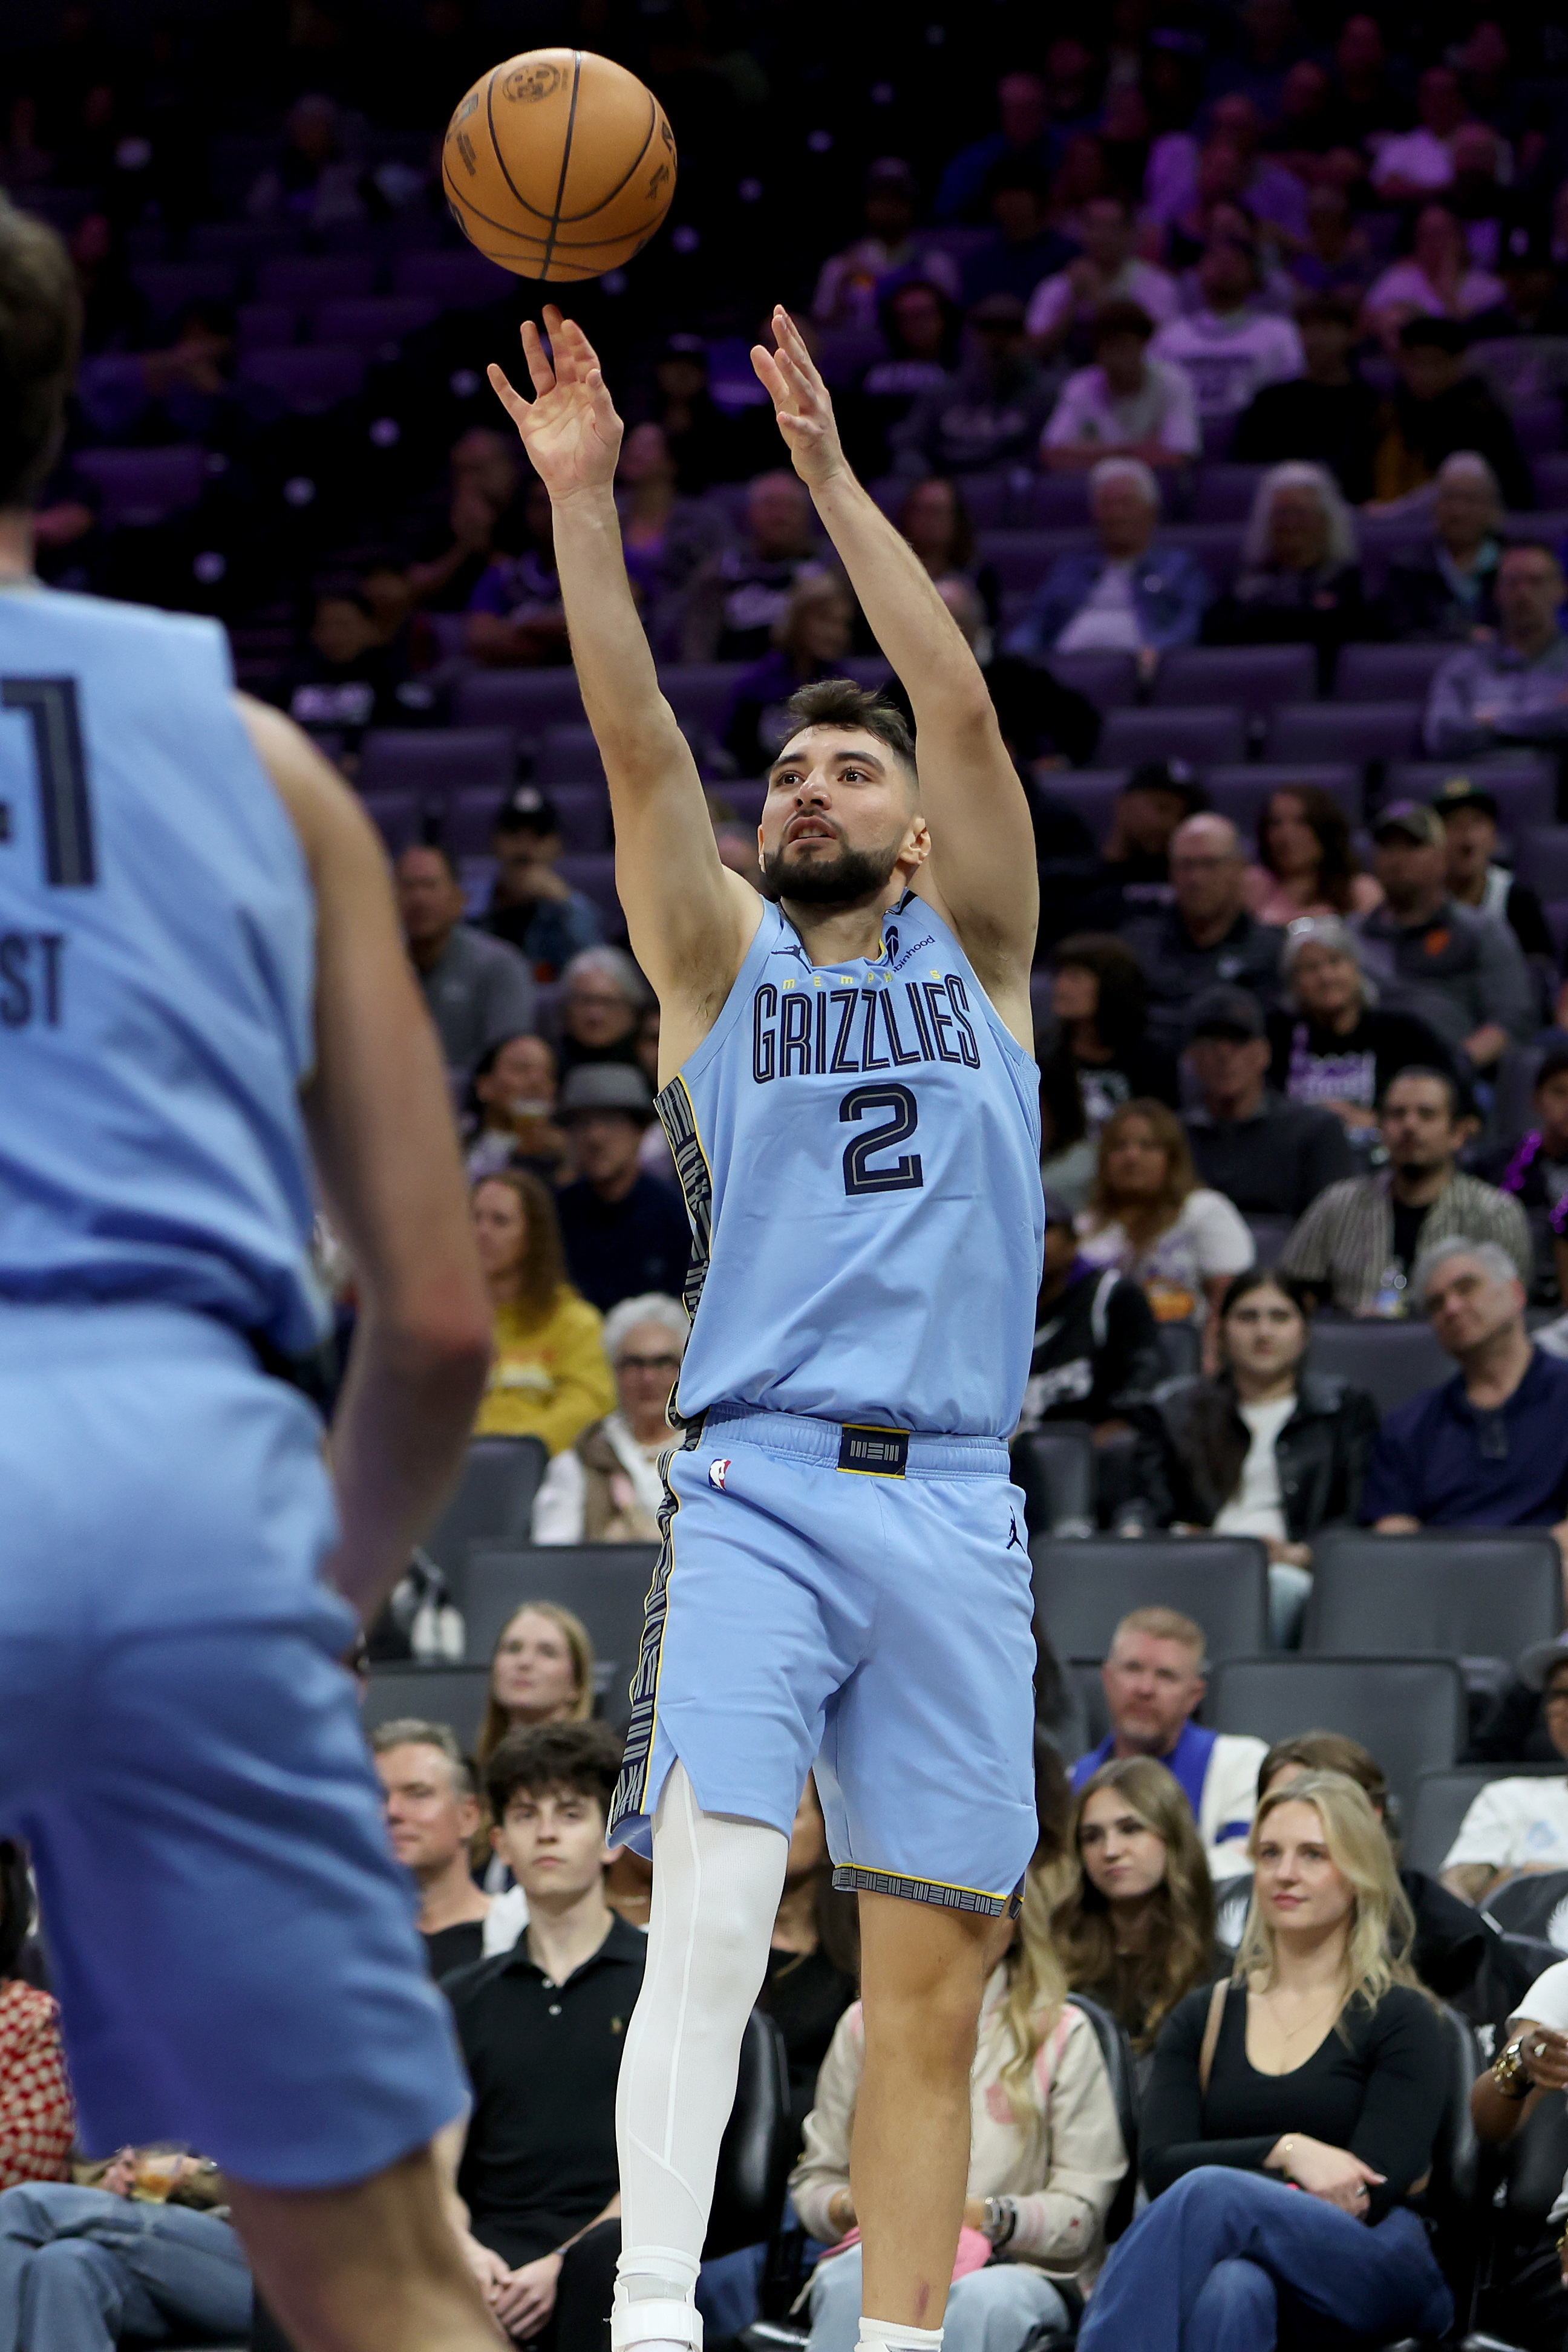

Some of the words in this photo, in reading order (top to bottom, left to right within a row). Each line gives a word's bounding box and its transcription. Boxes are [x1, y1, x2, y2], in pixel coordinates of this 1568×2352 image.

[0, 676, 95, 887] 1
[753, 974, 980, 1083] GRIZZLIES
[839, 1083, 923, 1195] 2
